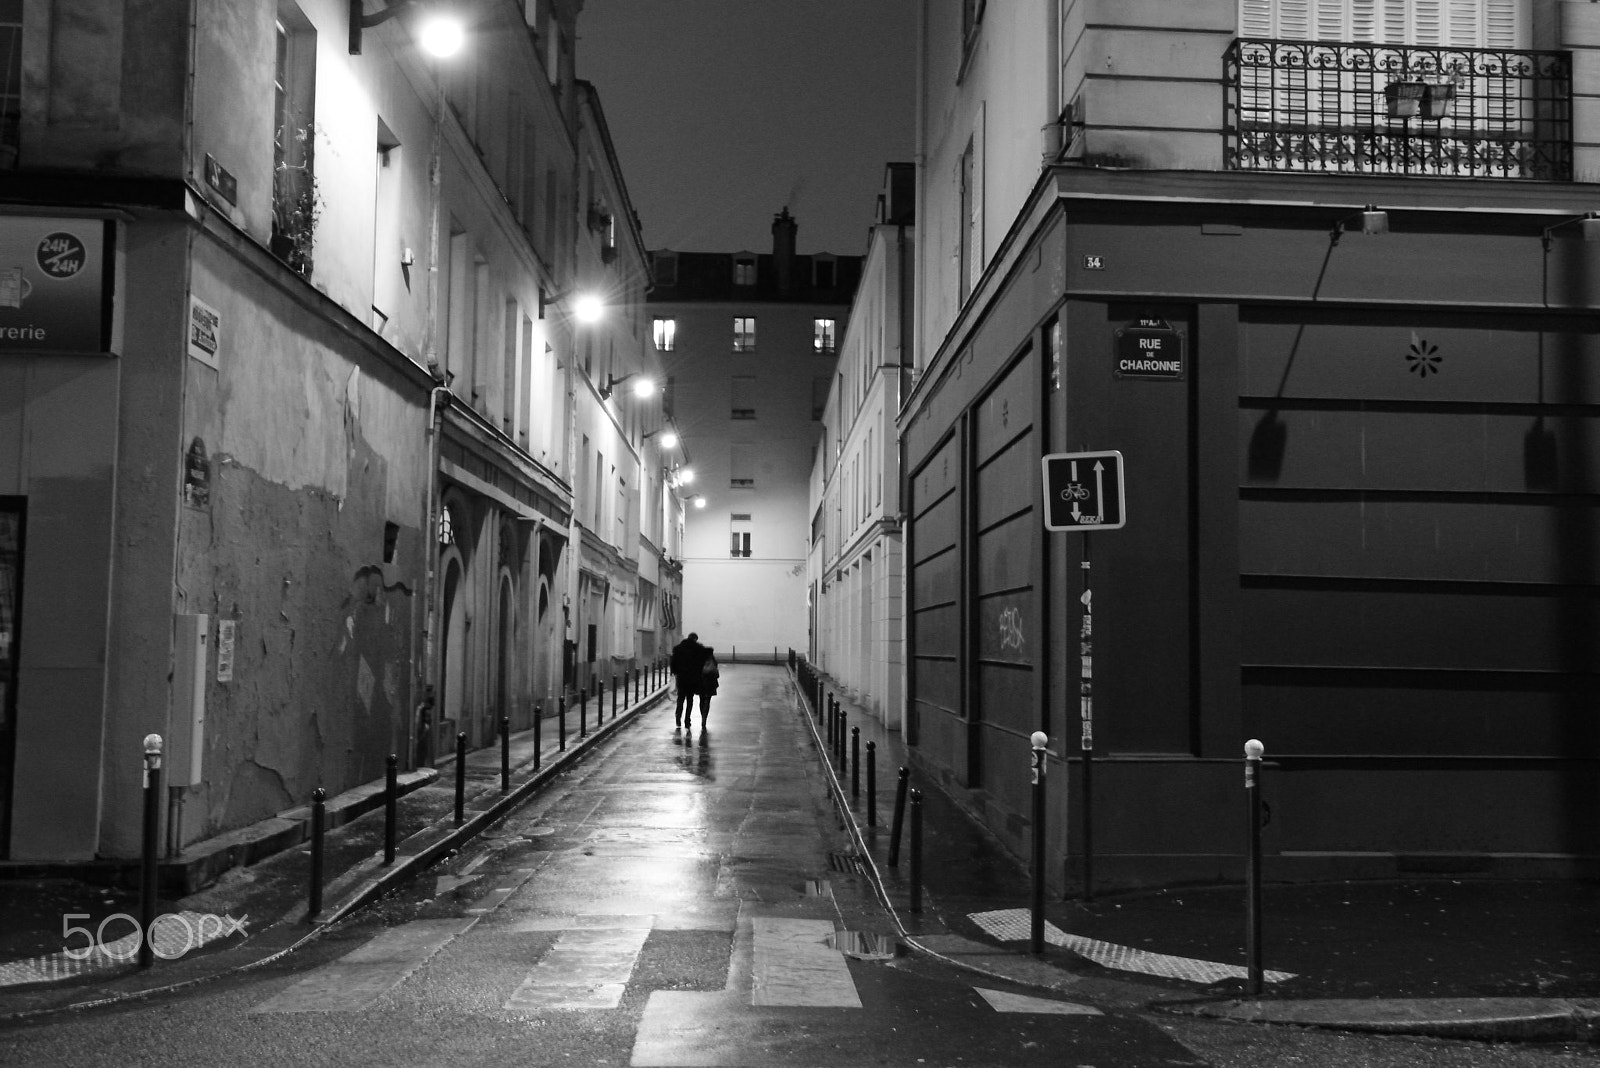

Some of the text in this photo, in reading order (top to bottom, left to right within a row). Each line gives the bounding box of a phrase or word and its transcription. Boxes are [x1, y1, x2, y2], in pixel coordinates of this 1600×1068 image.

[42, 238, 70, 252] 24H
[51, 260, 79, 272] 24H
[1087, 257, 1101, 268] 34
[1139, 339, 1161, 349] RUE
[1120, 360, 1180, 371] CHARONNE
